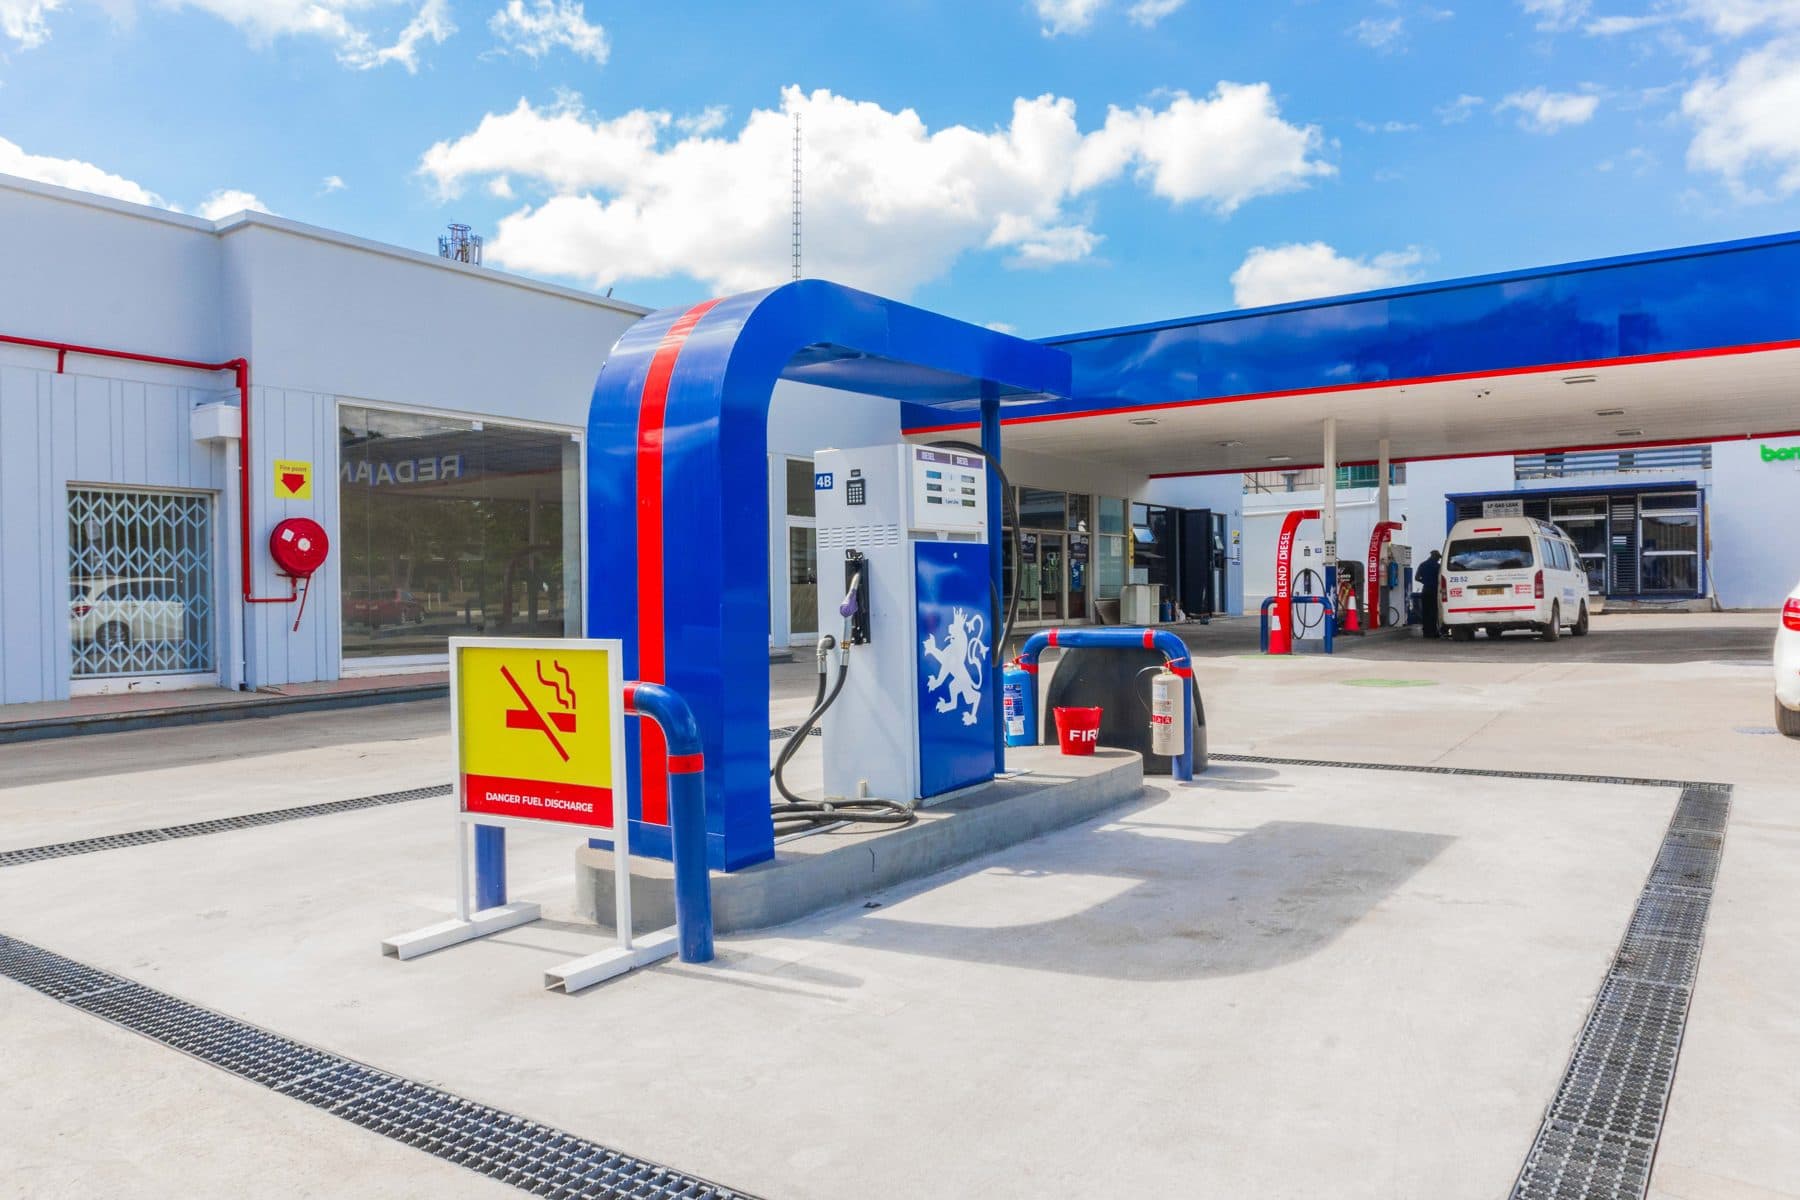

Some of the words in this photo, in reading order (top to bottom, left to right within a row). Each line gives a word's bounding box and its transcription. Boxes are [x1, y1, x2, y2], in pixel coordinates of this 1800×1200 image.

[816, 475, 832, 488] 4B
[1279, 531, 1291, 560] DIESEL
[1278, 566, 1287, 598] BLEND
[485, 792, 520, 803] DANGER
[522, 795, 543, 806] FUEL
[545, 798, 593, 812] DISCHARGE
